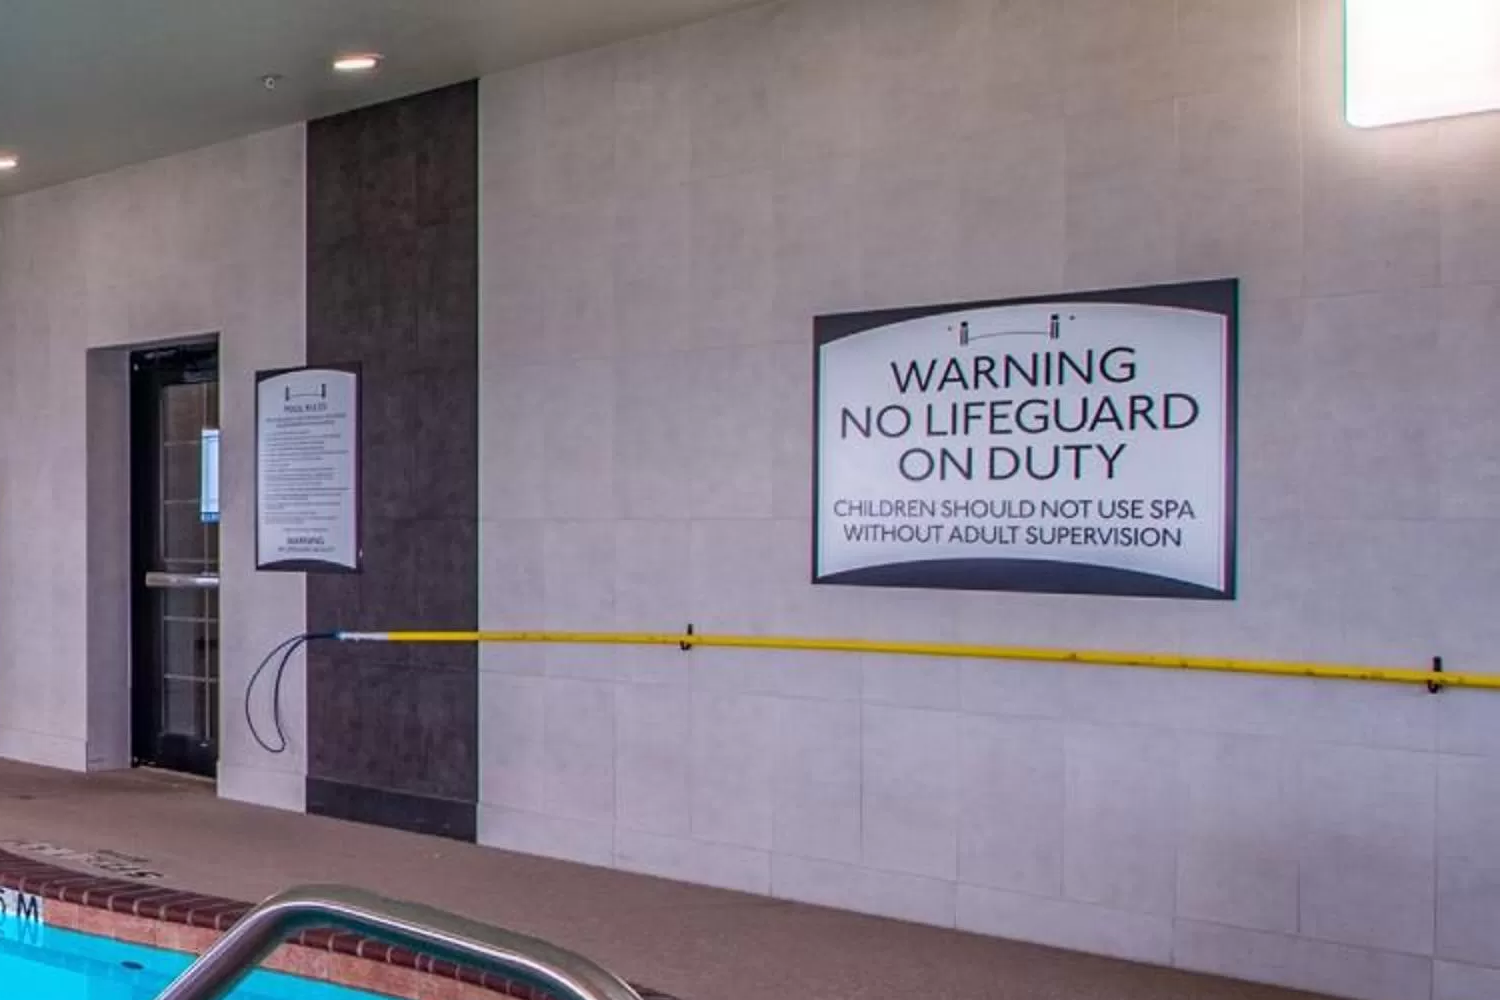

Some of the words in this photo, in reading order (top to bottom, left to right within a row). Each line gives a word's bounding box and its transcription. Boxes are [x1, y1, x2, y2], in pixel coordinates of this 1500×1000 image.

[890, 346, 1137, 394] WARNING
[840, 403, 912, 440] NO
[926, 393, 1200, 437] LIFEGUARD
[898, 447, 973, 482] ON
[988, 443, 1127, 481] DUTY
[833, 498, 936, 518] CHILDREN
[940, 499, 1036, 519] SHOULD
[1040, 499, 1093, 519] NOT
[1097, 499, 1145, 520] USE
[1149, 498, 1197, 520] SPA
[843, 523, 945, 544] WITHOUT
[947, 525, 1021, 545] ADULT
[1025, 526, 1182, 548] SUPERVISION
